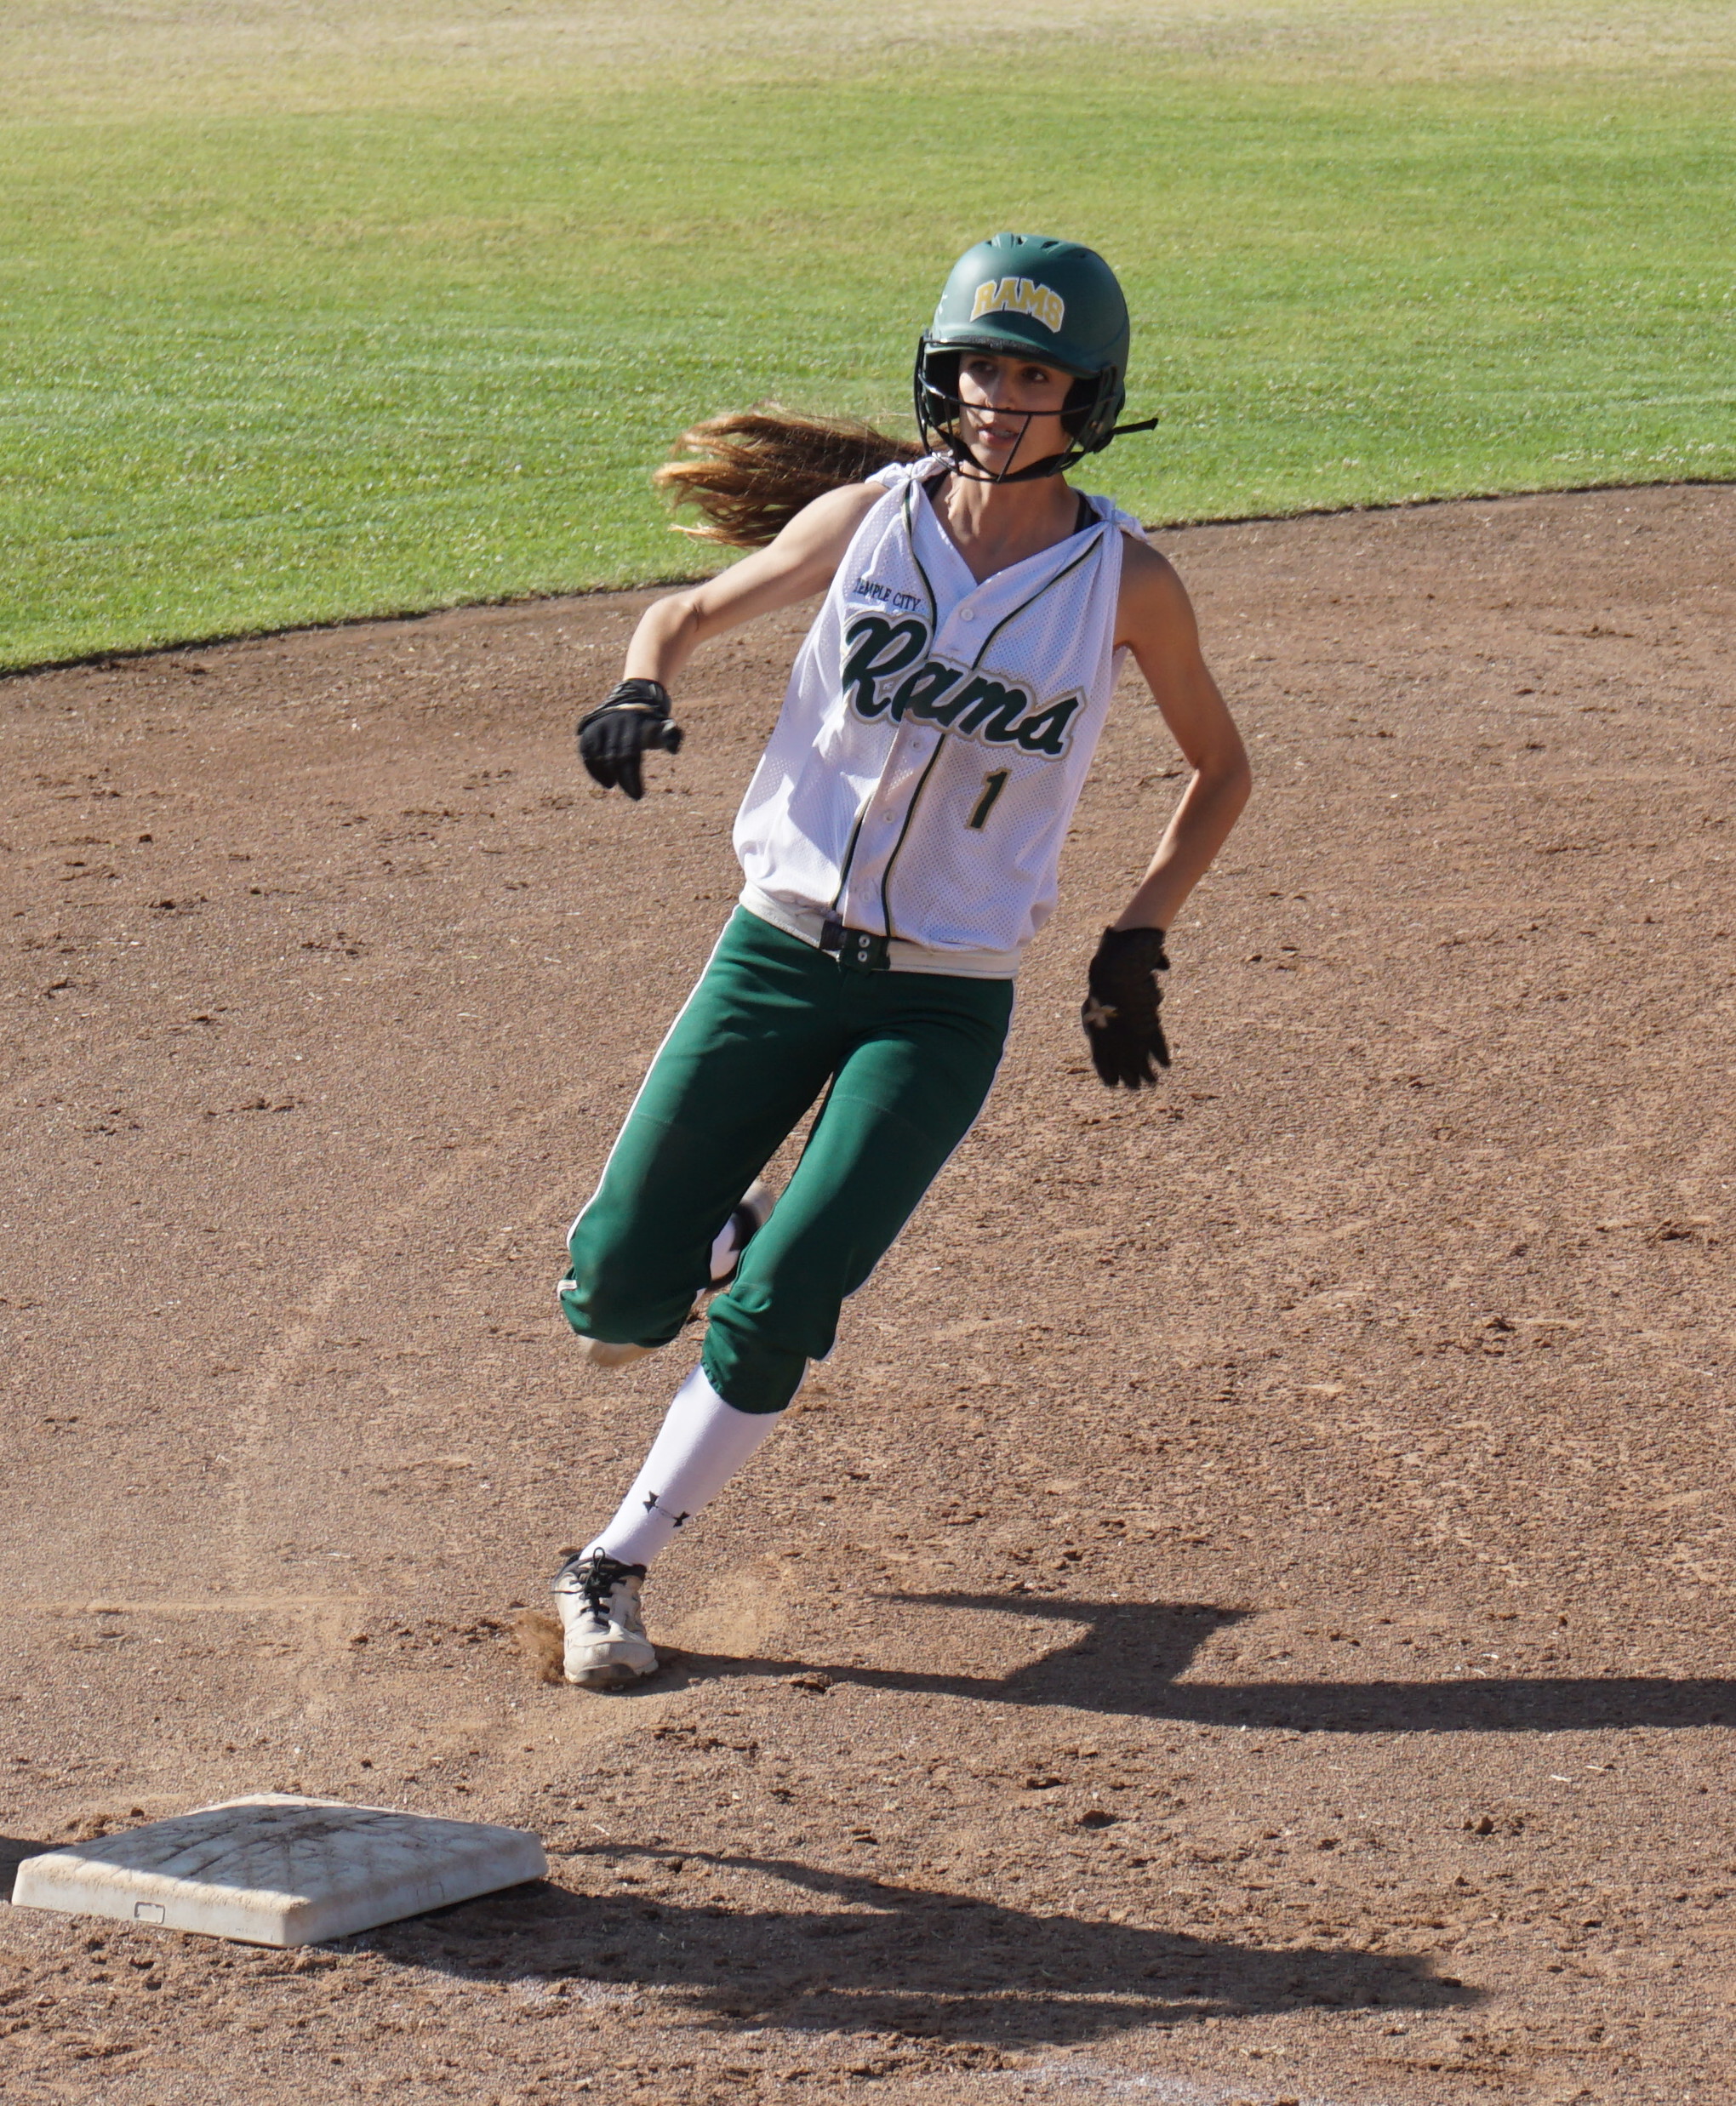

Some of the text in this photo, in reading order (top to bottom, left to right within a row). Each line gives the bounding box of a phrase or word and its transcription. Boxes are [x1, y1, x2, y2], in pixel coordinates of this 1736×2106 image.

[970, 277, 1065, 333] RAMS
[853, 578, 921, 611] TEMPLE CITY
[841, 613, 1085, 760] Rams
[966, 768, 1010, 830] 1
